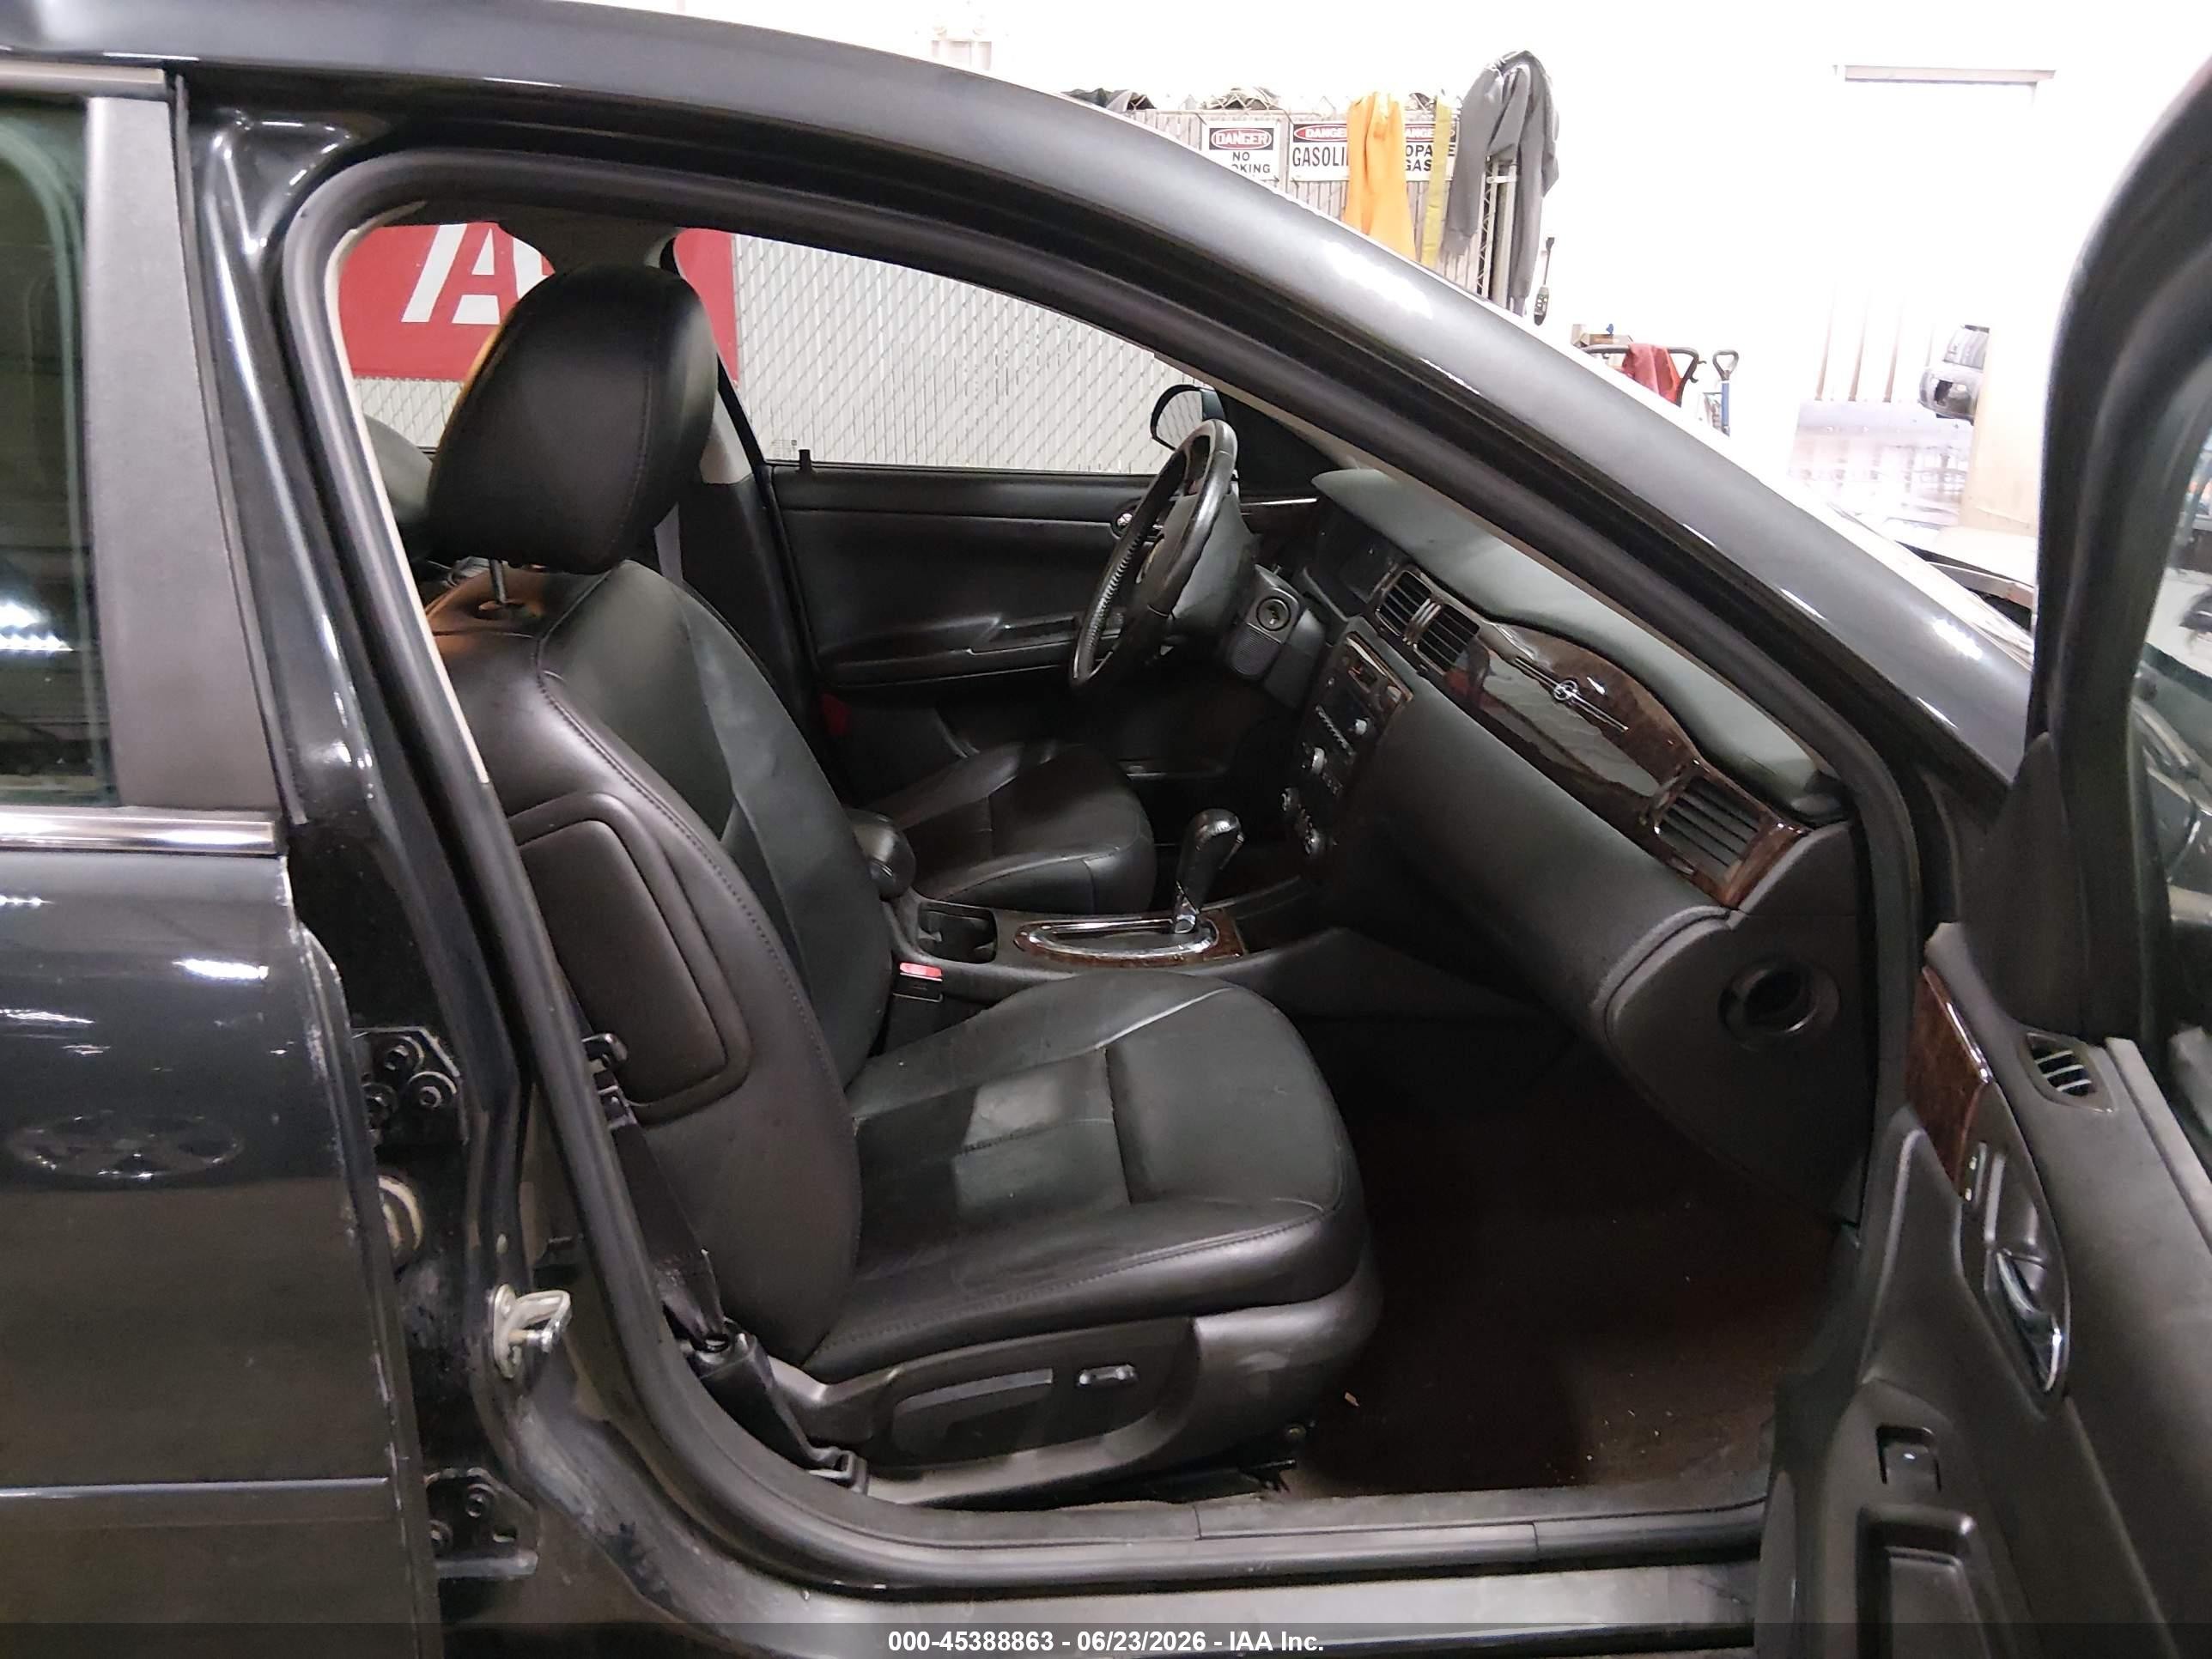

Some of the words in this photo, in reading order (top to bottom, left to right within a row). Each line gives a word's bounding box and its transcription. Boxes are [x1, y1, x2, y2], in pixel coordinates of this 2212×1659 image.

[1215, 131, 1267, 145] DANGER
[1232, 151, 1250, 161] NO
[1292, 146, 1349, 167] GASOLI
